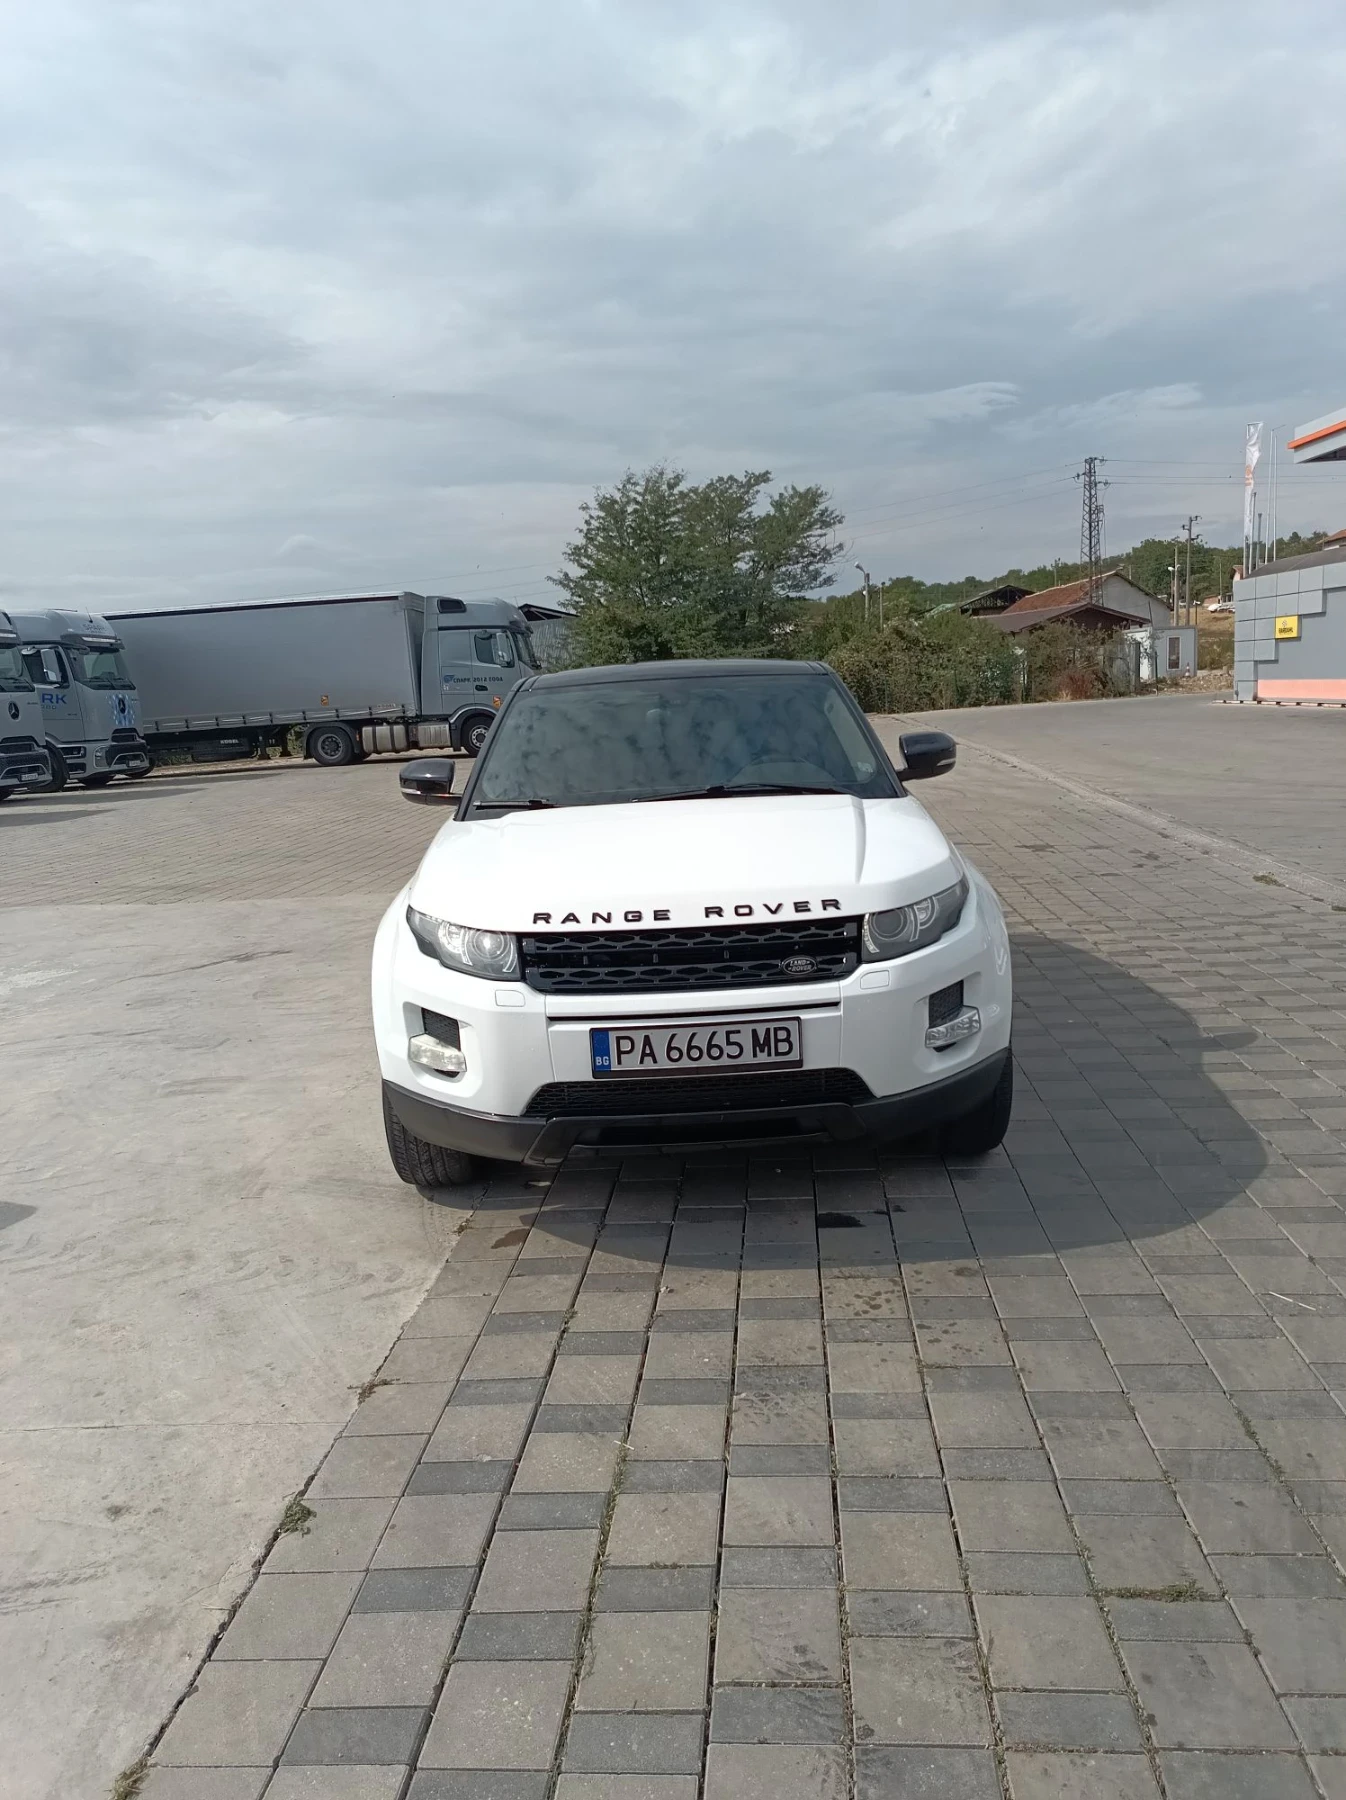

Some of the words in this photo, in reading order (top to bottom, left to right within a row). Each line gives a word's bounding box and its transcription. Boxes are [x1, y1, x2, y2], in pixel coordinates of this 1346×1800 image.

[532, 908, 672, 924] RANGE
[704, 898, 842, 918] ROVER
[595, 1056, 610, 1066] BG
